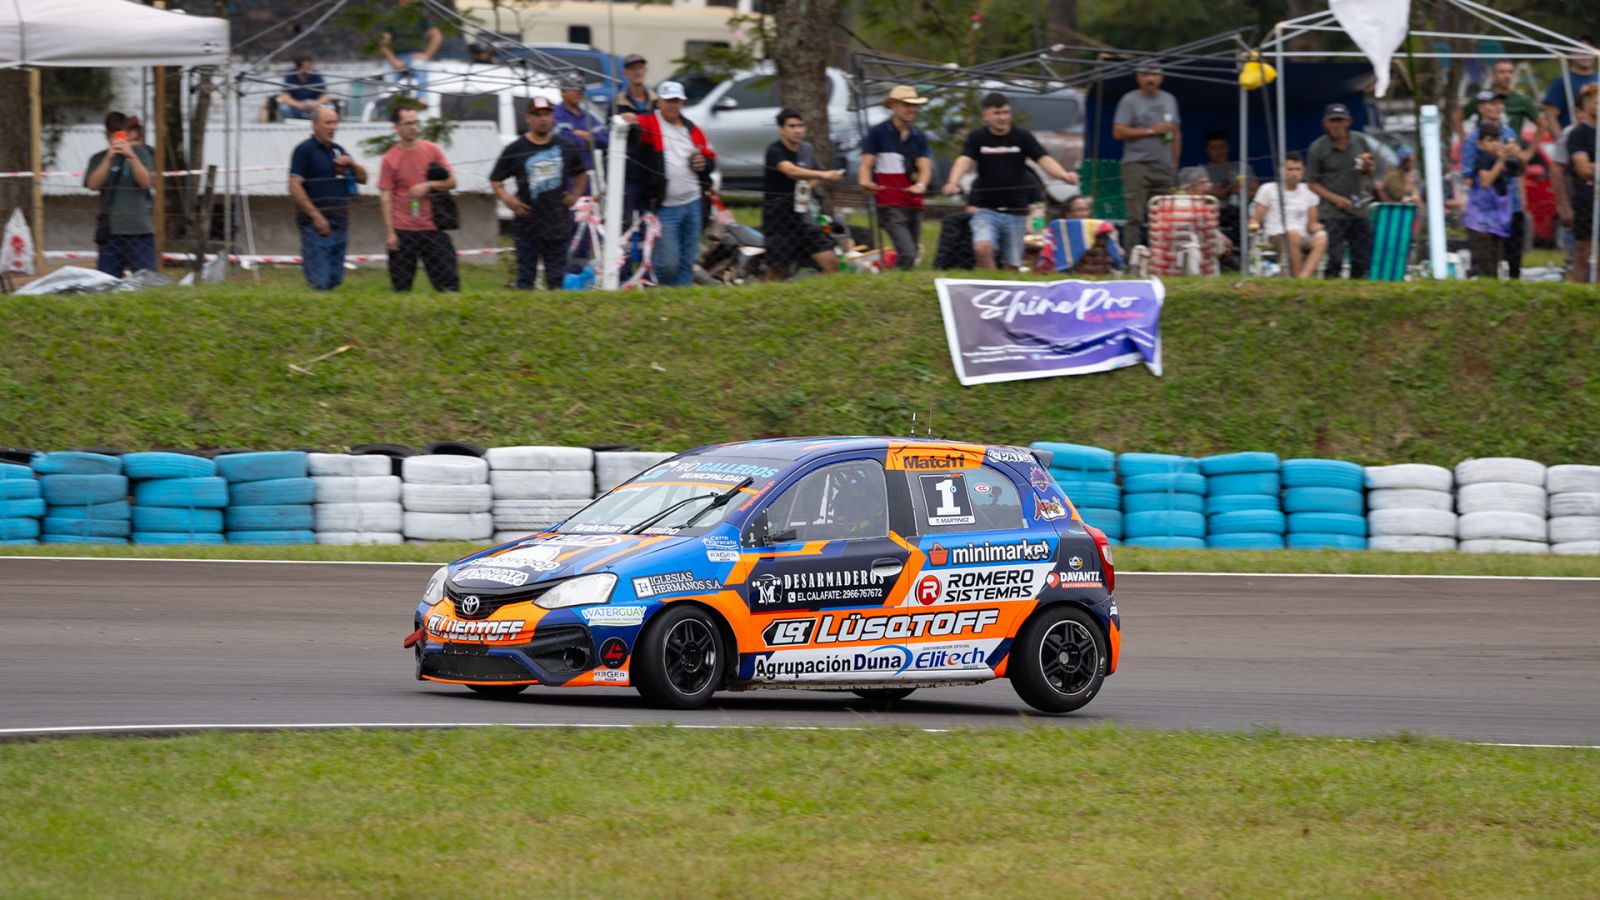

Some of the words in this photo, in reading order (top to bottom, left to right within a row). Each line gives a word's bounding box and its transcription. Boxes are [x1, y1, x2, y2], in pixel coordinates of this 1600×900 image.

[972, 288, 1140, 322] ShinePro
[696, 462, 779, 478] GALLEGOS
[935, 479, 961, 515] 1
[952, 540, 1051, 564] minimarket
[650, 572, 694, 587] IGLESIAS
[652, 580, 706, 595] HERMANOS
[706, 578, 723, 590] S.A.
[784, 569, 884, 590] DESARMADEROS
[947, 569, 1034, 588] ROMERO
[1060, 572, 1099, 582] DAVANTI
[798, 592, 805, 601] EL
[806, 590, 842, 600] CALAFATE:
[944, 585, 1033, 602] SISTEMAS
[583, 607, 645, 618] WATERGUAY
[816, 611, 998, 643] LÜSQTOFF
[757, 655, 851, 679] Agrupación
[854, 652, 901, 670] Duna
[916, 647, 984, 668] Elitech
